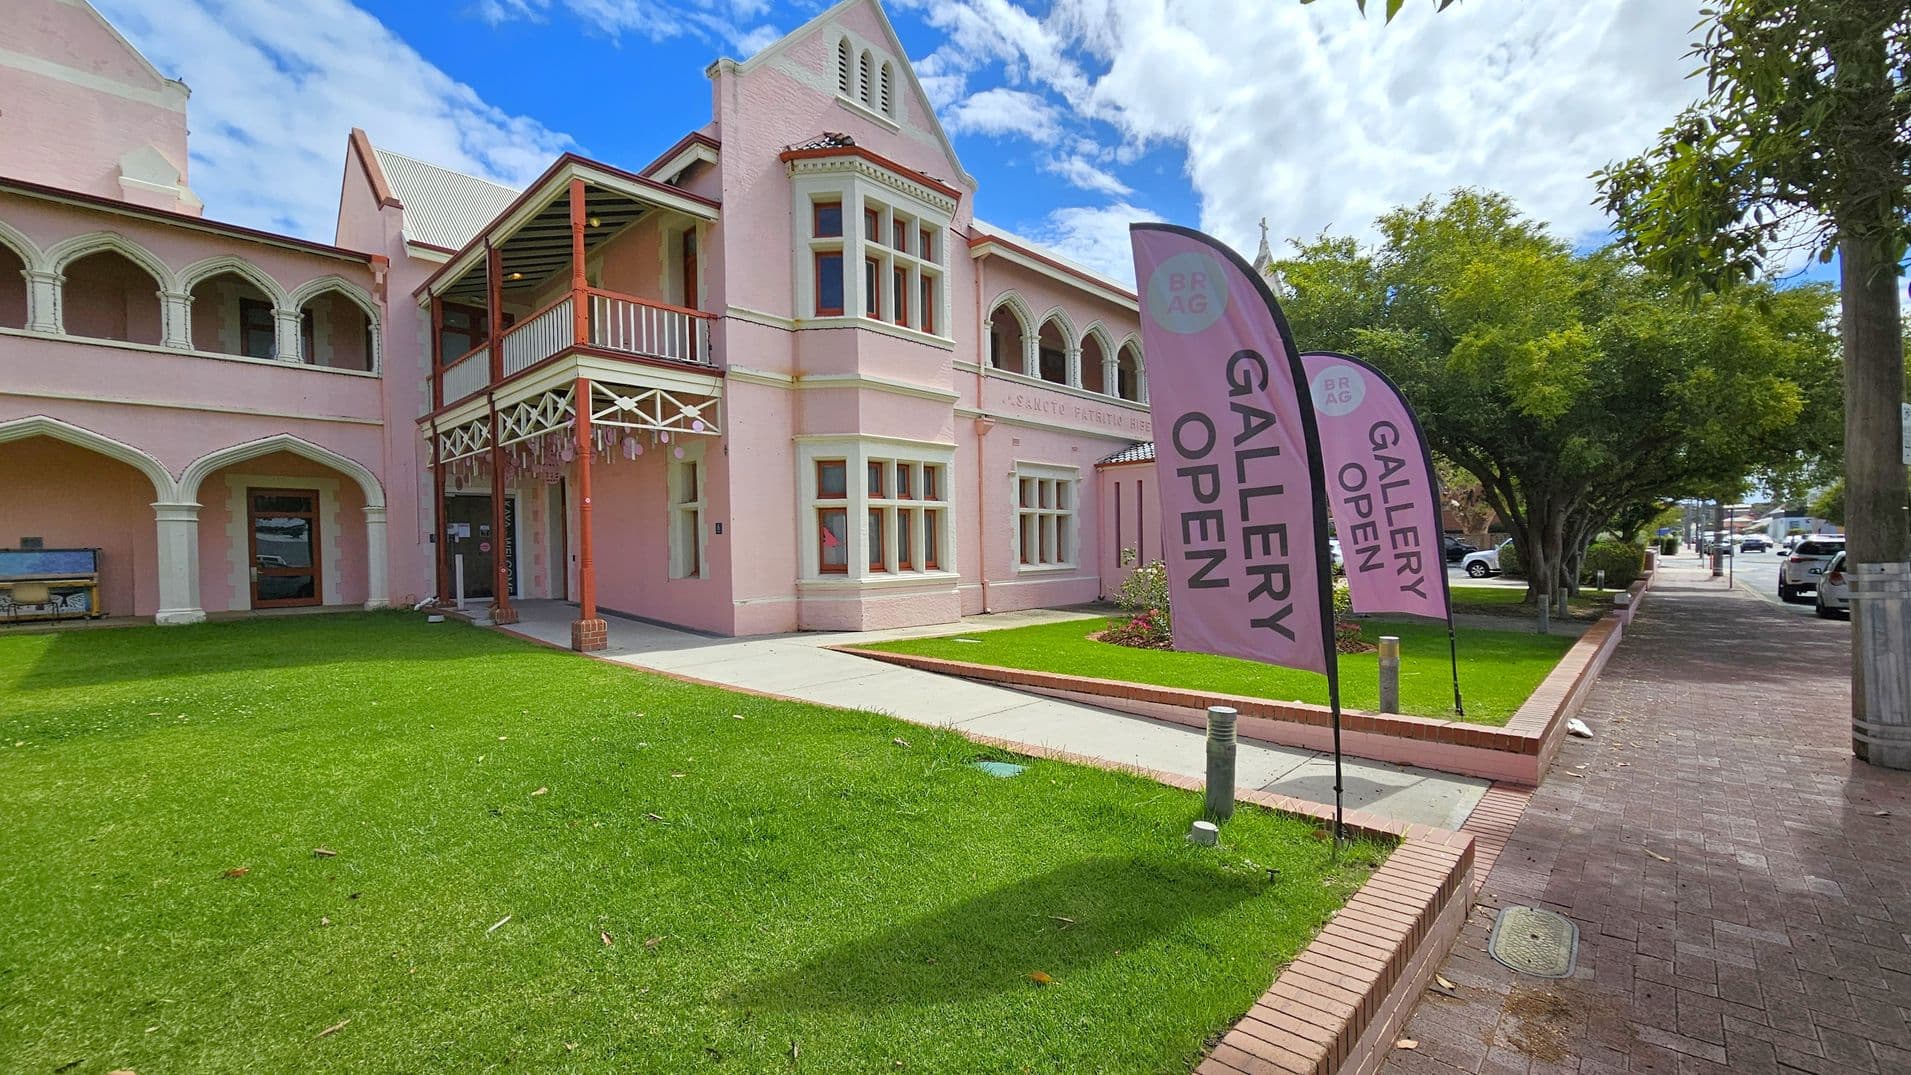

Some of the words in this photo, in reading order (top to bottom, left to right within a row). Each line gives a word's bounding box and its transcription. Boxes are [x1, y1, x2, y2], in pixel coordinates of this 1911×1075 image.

[1168, 272, 1207, 292] BR
[1167, 294, 1208, 315] AG
[1324, 377, 1350, 391] BR
[1324, 391, 1352, 405] AG
[1016, 395, 1065, 415] SANCTO
[1074, 407, 1123, 426] PATRITIO
[1172, 411, 1230, 590] OPEN
[1225, 349, 1296, 643] GALLERY
[1368, 420, 1428, 600] GALLERY
[1338, 462, 1385, 573] OPEN
